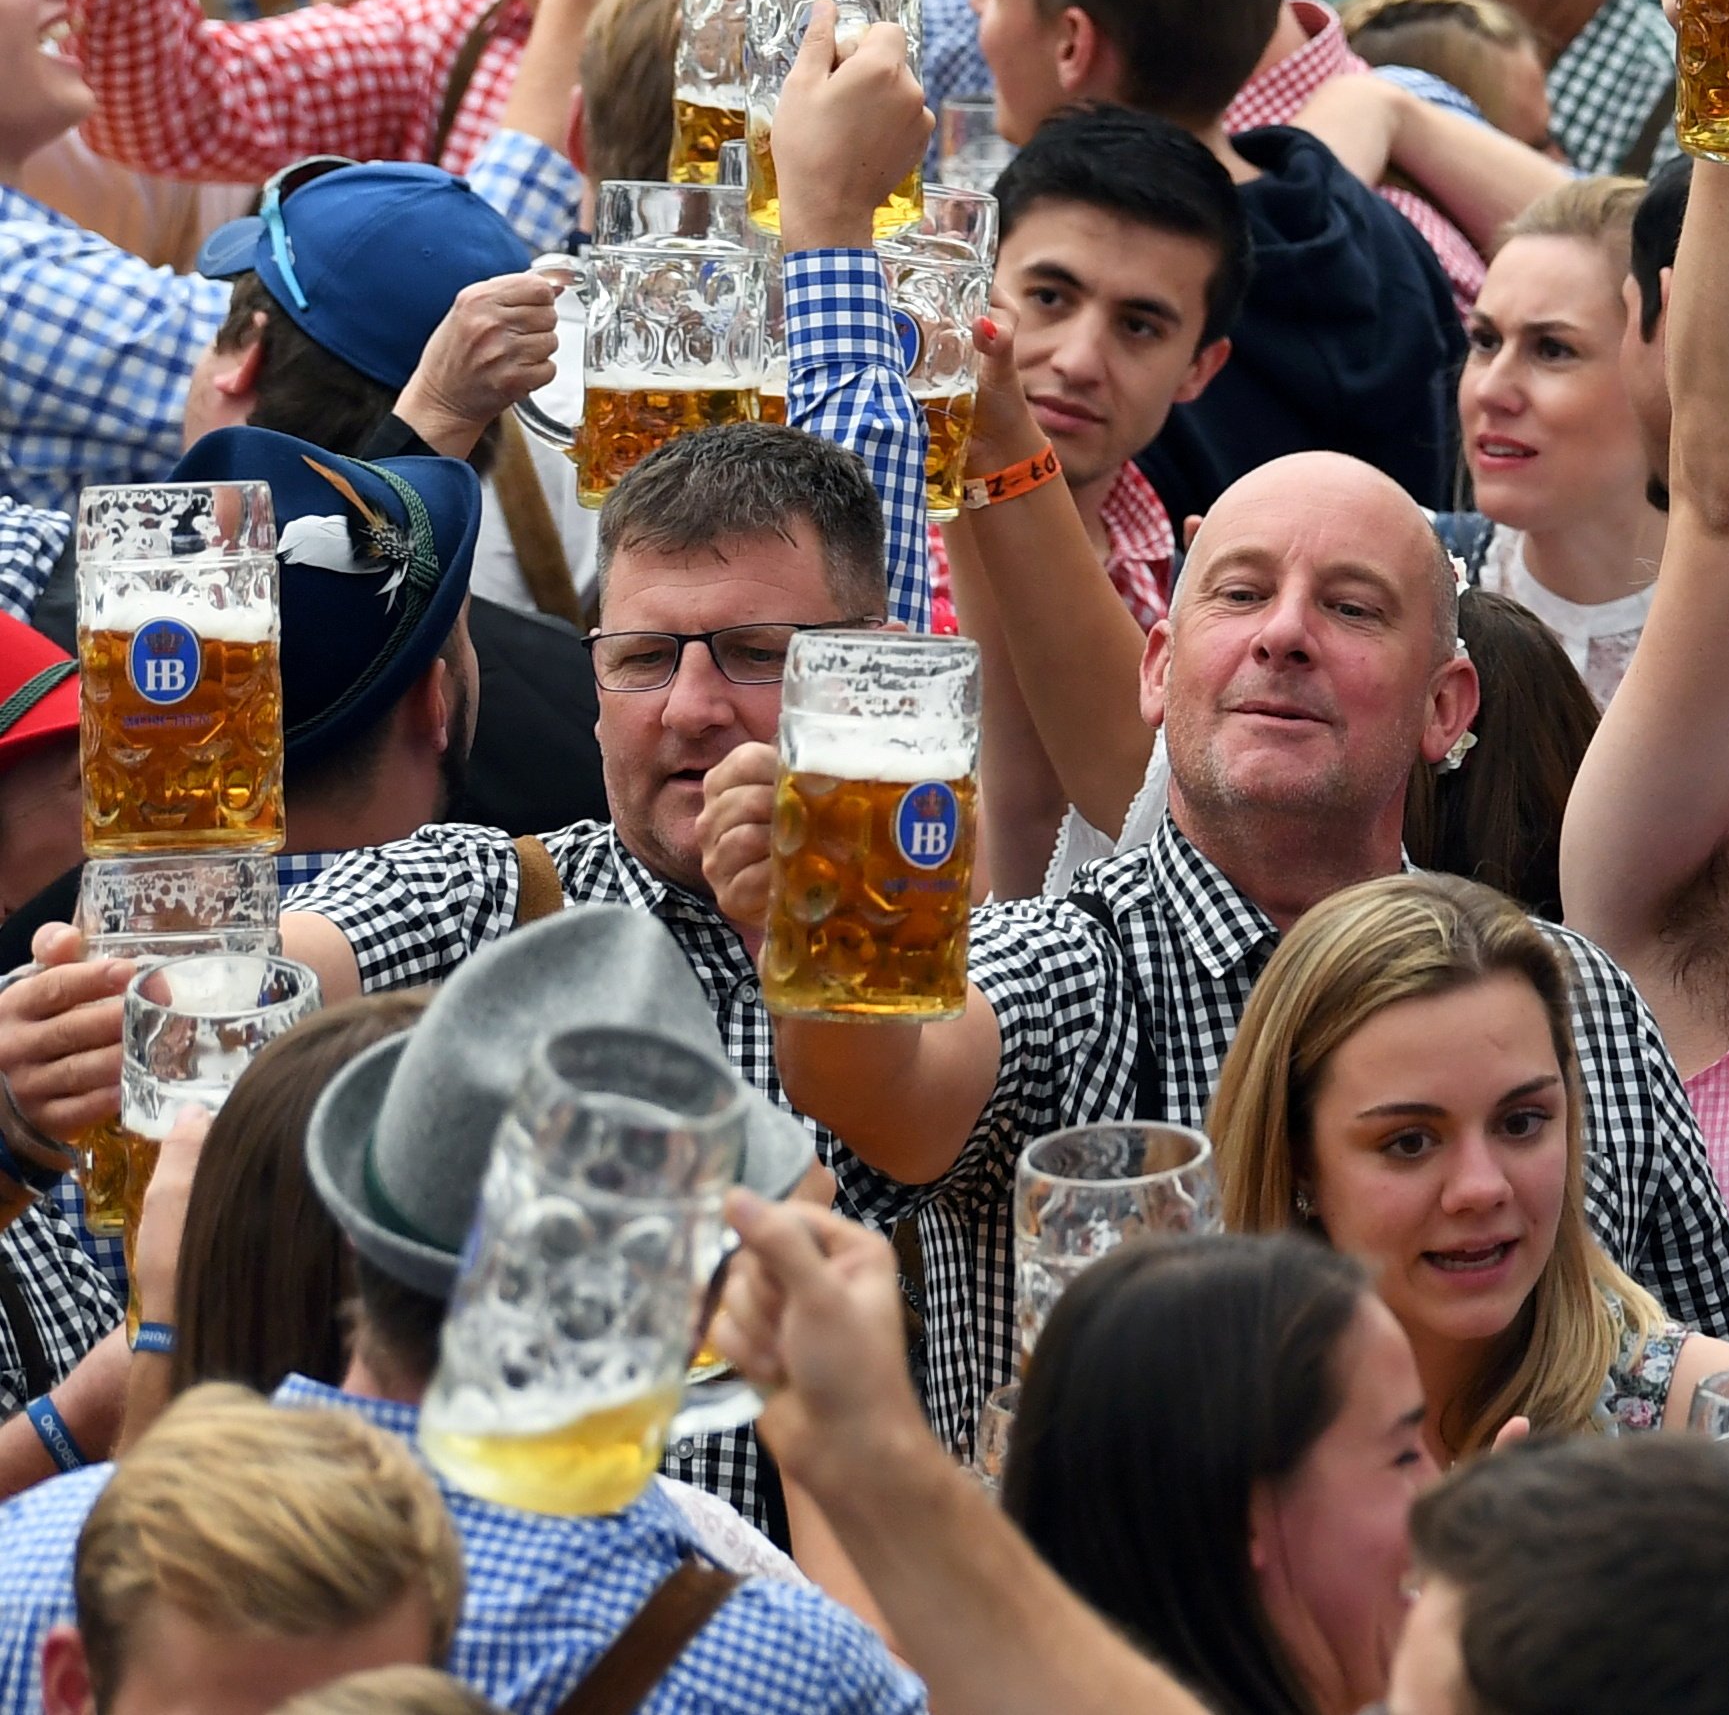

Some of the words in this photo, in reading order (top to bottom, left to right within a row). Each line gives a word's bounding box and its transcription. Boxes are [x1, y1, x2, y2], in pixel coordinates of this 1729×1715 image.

[145, 659, 186, 691] HB
[910, 821, 947, 856] HB
[40, 1413, 81, 1470] OKTOBE
